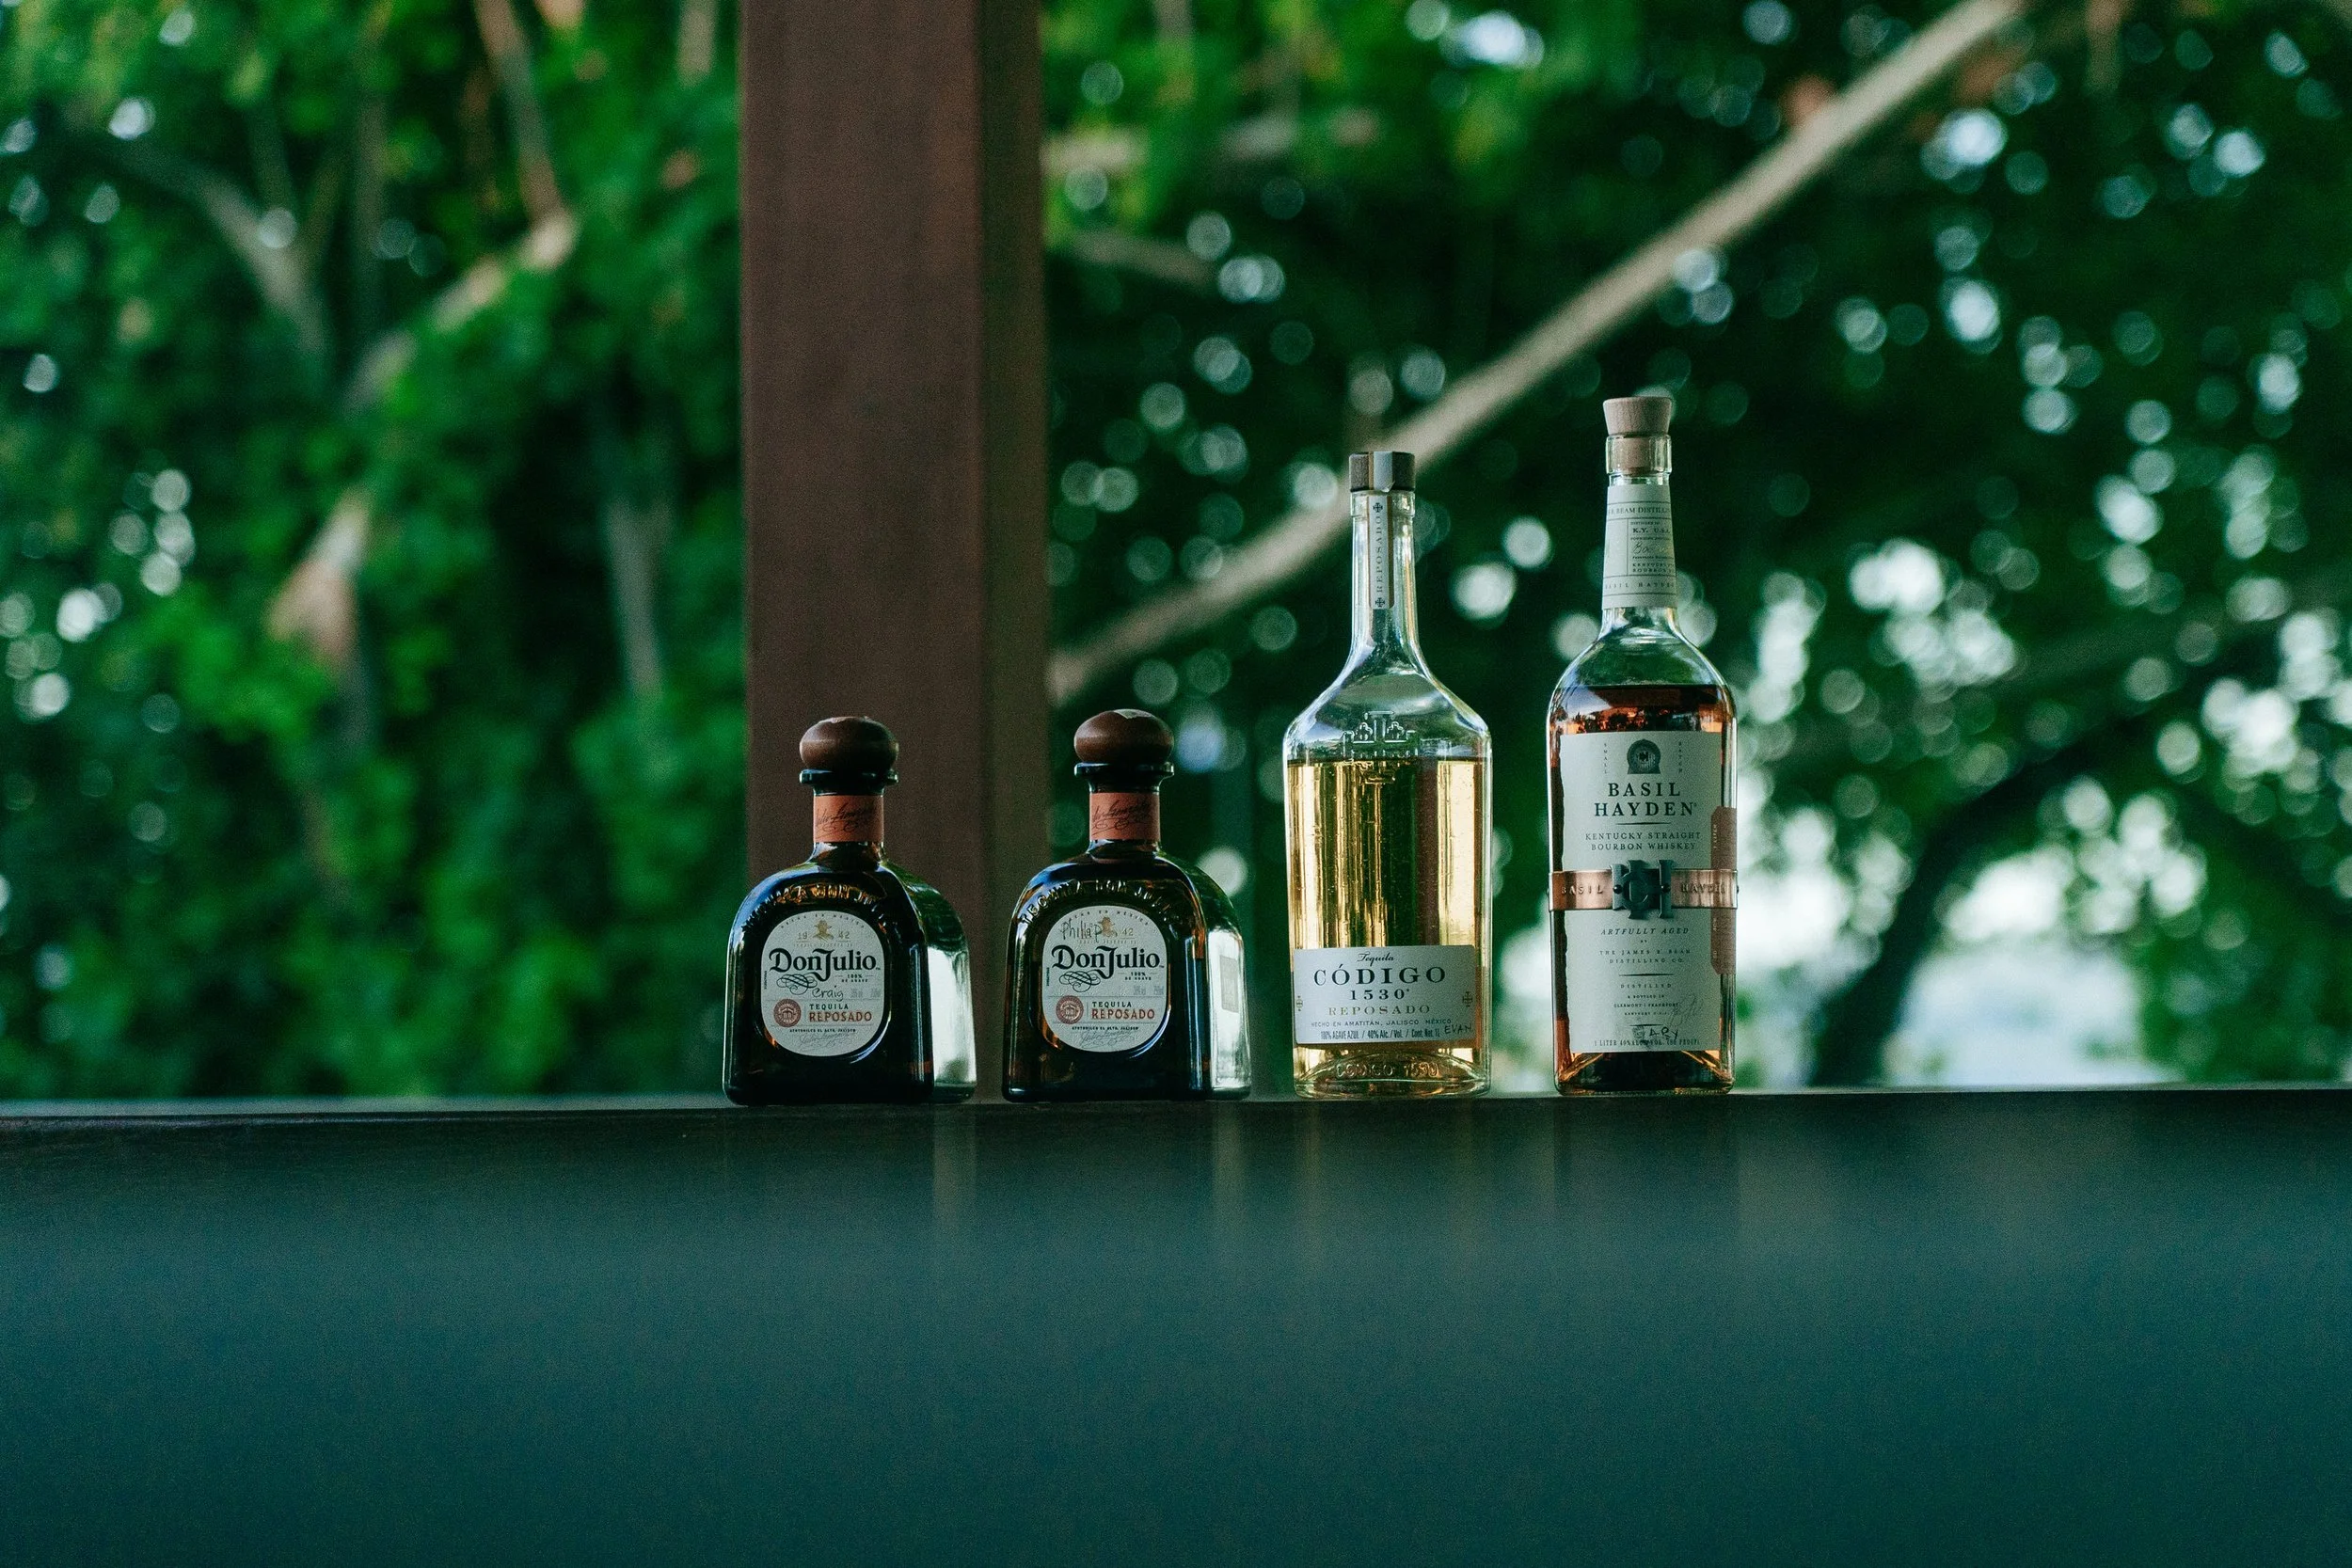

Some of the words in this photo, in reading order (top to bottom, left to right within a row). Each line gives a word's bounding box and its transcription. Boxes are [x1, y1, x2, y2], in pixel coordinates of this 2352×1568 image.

[1608, 783, 1681, 797] BASIL
[1594, 802, 1693, 817] HAYDEN
[1586, 832, 1642, 840] KENTUCKY
[1122, 928, 1133, 936] 42
[1357, 951, 1394, 967] Tequila
[1314, 964, 1446, 986] CÓDIGO
[812, 985, 844, 1002] Craig
[1092, 1009, 1155, 1020] REPOSADO
[1328, 1005, 1430, 1016] REPOSADO
[809, 1011, 873, 1022] REPOSADO
[1367, 1030, 1379, 1038] 40%
[1445, 1023, 1472, 1034] EVAN
